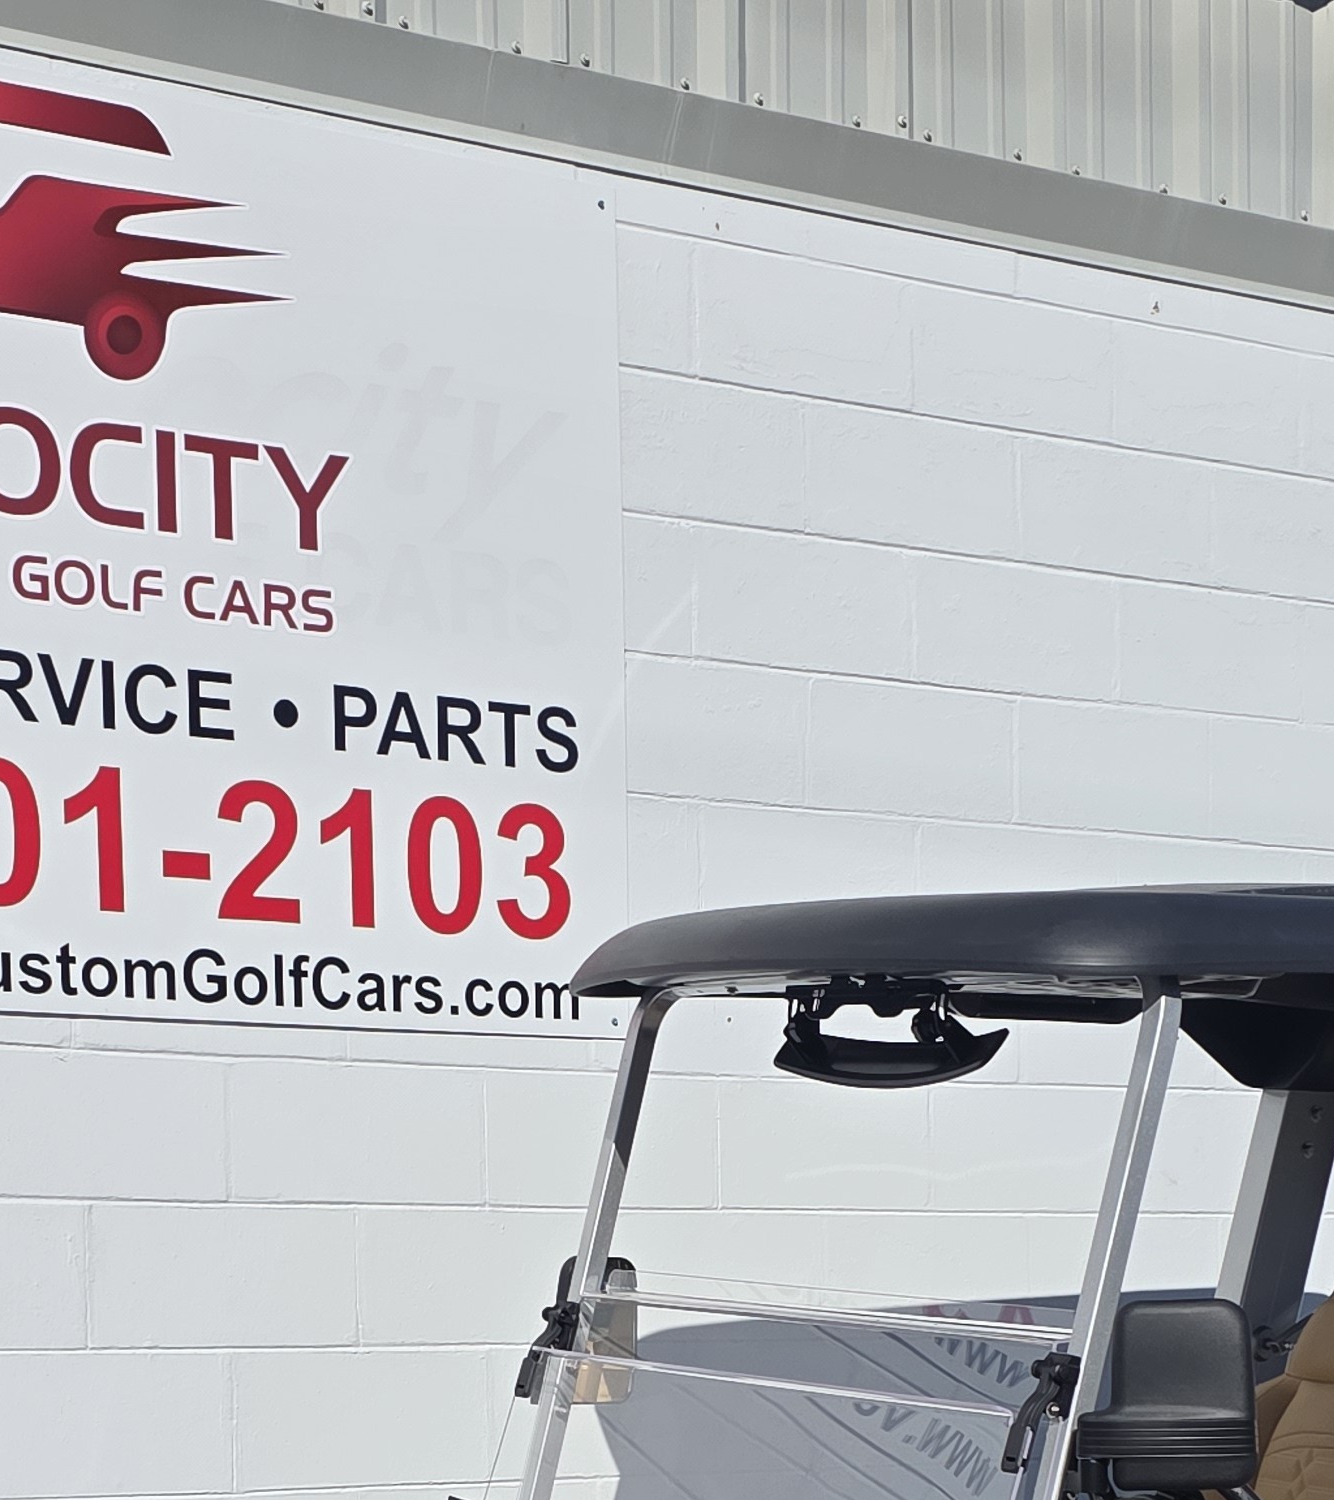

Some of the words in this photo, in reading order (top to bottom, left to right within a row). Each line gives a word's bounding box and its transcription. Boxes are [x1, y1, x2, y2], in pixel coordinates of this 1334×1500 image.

[12, 555, 163, 612] GOLF
[184, 575, 334, 633] CARS
[333, 684, 579, 773] PARTS
